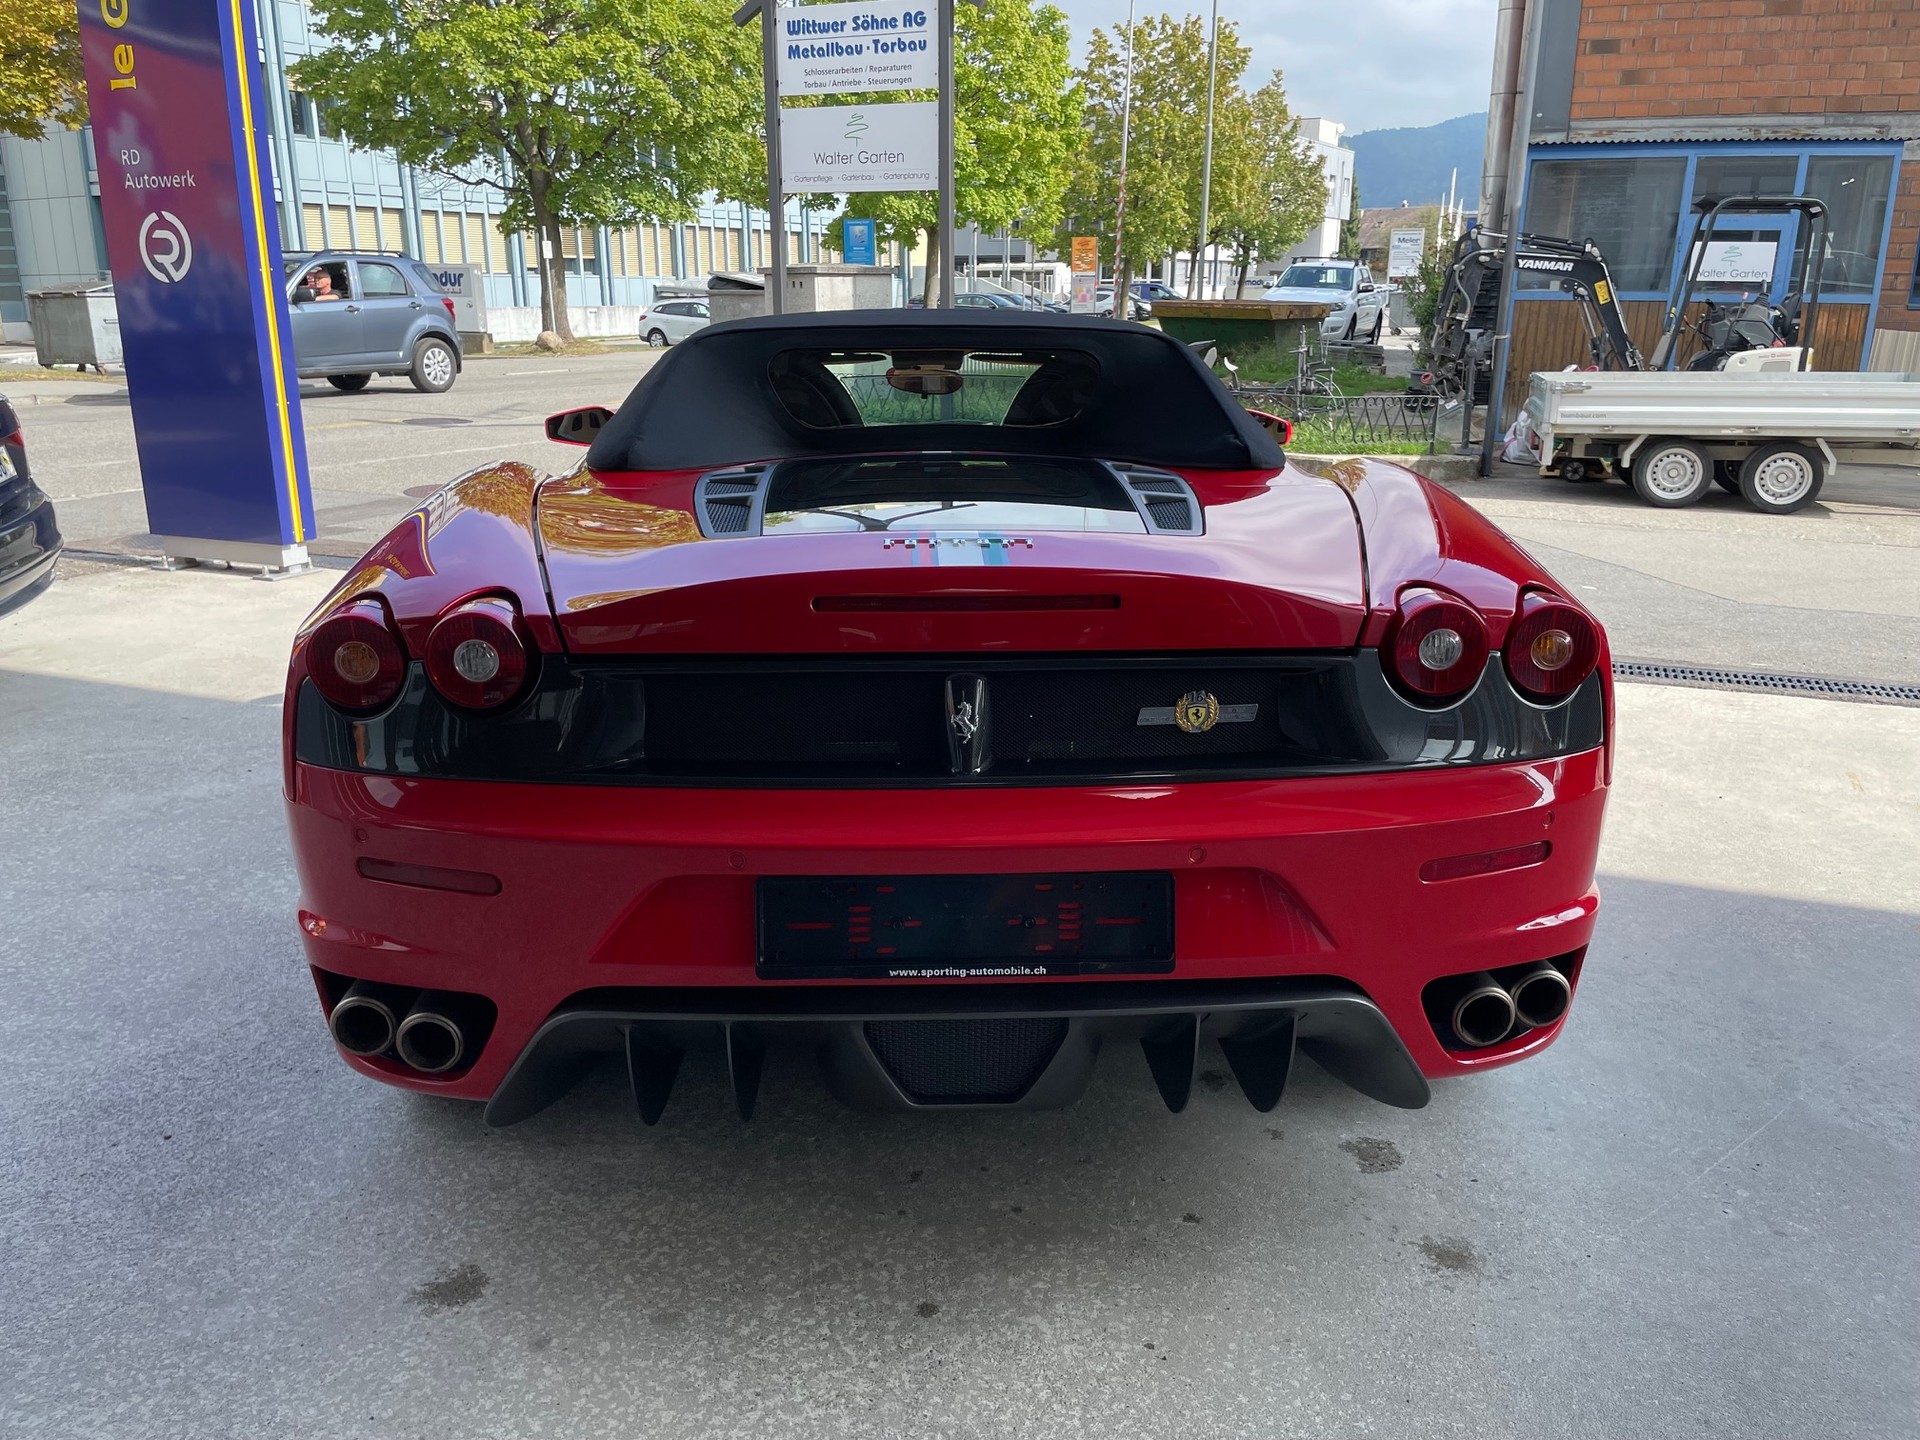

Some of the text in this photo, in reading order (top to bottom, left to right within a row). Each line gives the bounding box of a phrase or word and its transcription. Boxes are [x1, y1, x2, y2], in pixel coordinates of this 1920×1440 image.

[786, 10, 927, 36] Wittwer Söhne AG
[787, 37, 927, 60] Metallbau Torbau
[804, 65, 863, 76] Schlosserarbeiten
[869, 63, 912, 74] Reparaturen
[804, 80, 827, 89] Torbau
[867, 76, 912, 86] Steuerungen
[121, 149, 141, 166] RD
[813, 150, 905, 165] Walter Garten
[125, 170, 196, 189] Autowerk
[793, 172, 930, 184] Gartenpflege Gartenbau Gartenplanung
[1517, 258, 1575, 272] YANMAR
[1729, 268, 1769, 279] Garten
[889, 965, 1047, 979] www.sporting-automobile.ch
